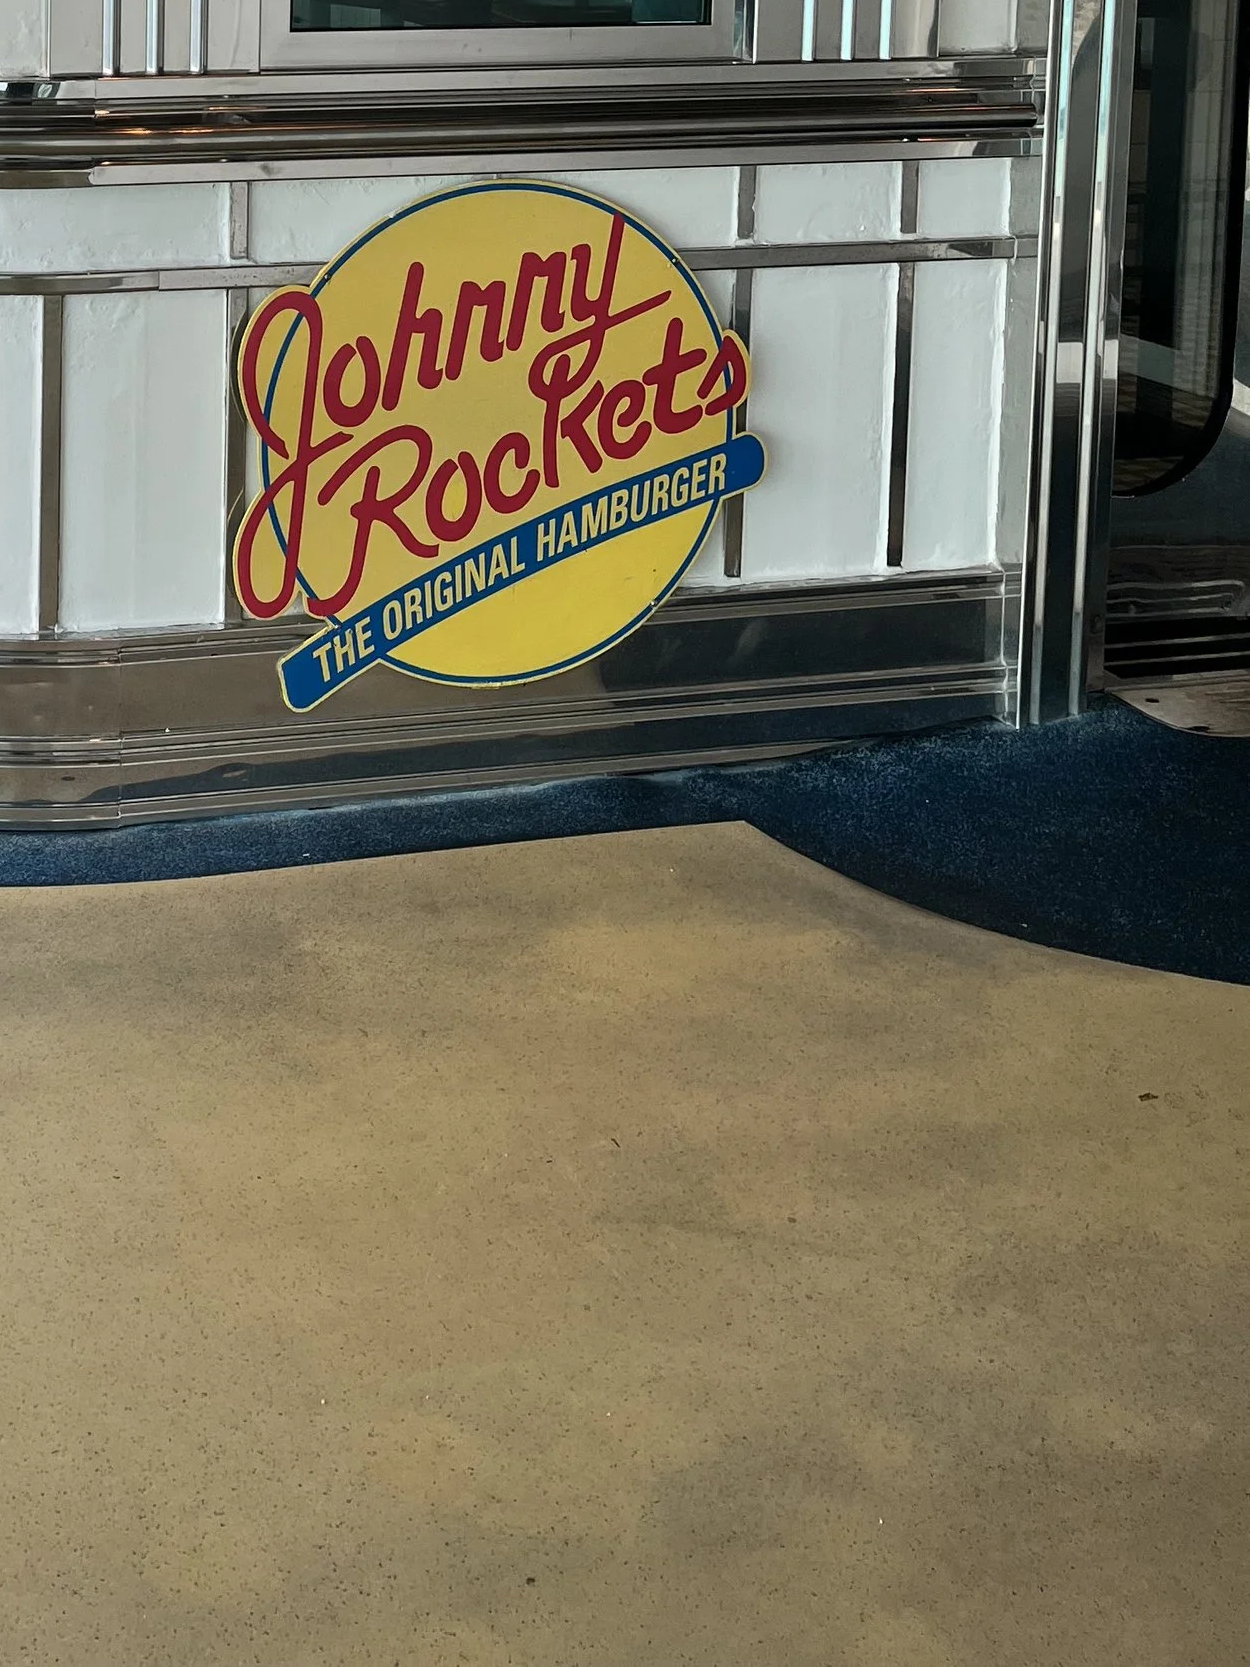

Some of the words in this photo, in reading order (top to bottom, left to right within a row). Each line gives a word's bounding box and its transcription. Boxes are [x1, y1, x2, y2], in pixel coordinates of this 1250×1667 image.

[237, 213, 672, 619] Johnny
[306, 317, 747, 617] Rockets
[313, 620, 375, 683] THE
[383, 539, 525, 639] ORIGINAL
[536, 452, 727, 563] HAMBURGER
